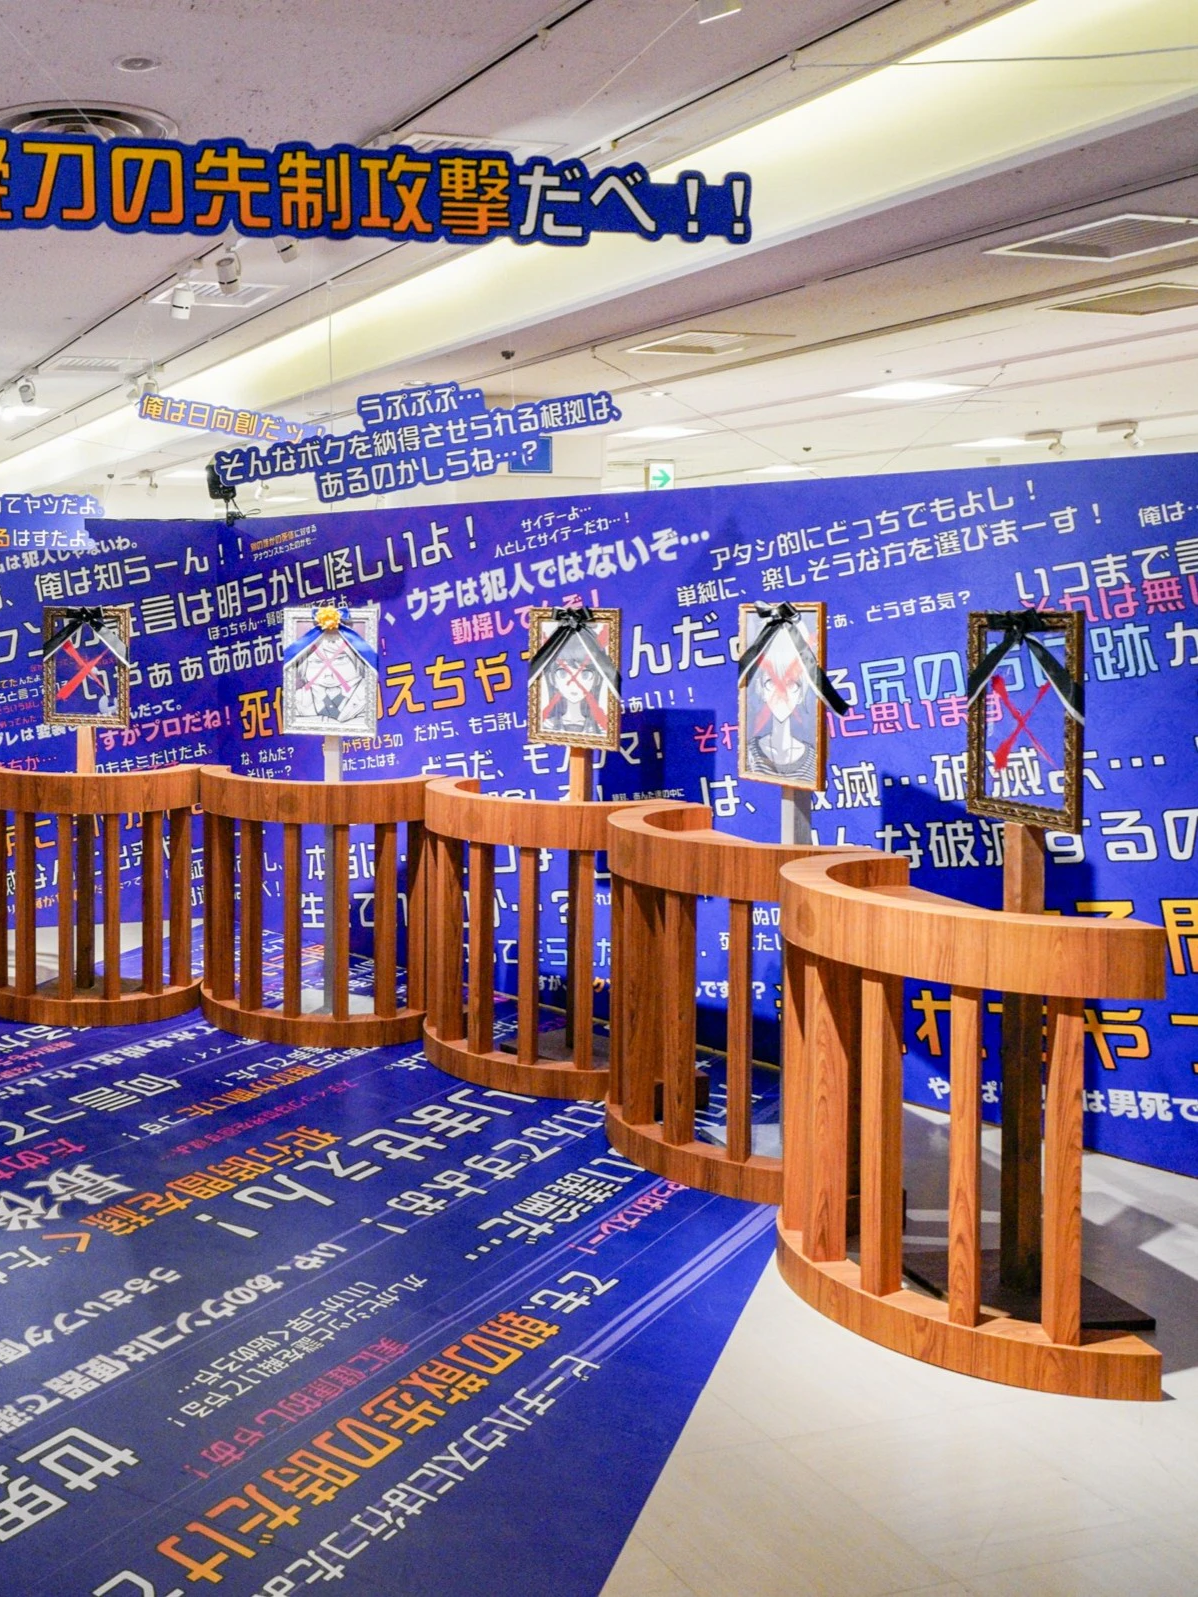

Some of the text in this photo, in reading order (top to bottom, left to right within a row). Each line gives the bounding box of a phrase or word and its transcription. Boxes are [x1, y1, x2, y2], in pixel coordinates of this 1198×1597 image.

[219, 393, 621, 482] そんなボクを納得させられる根拠は、
[494, 511, 631, 559] 人としてサイテーだわ…！
[521, 505, 592, 533] サイテーよ…
[709, 480, 1038, 572] アタシ的にどっちでもよし！
[676, 503, 1102, 608] 単純に、楽しそうな方を選びまーす！
[94, 706, 232, 753] すがプロだね！
